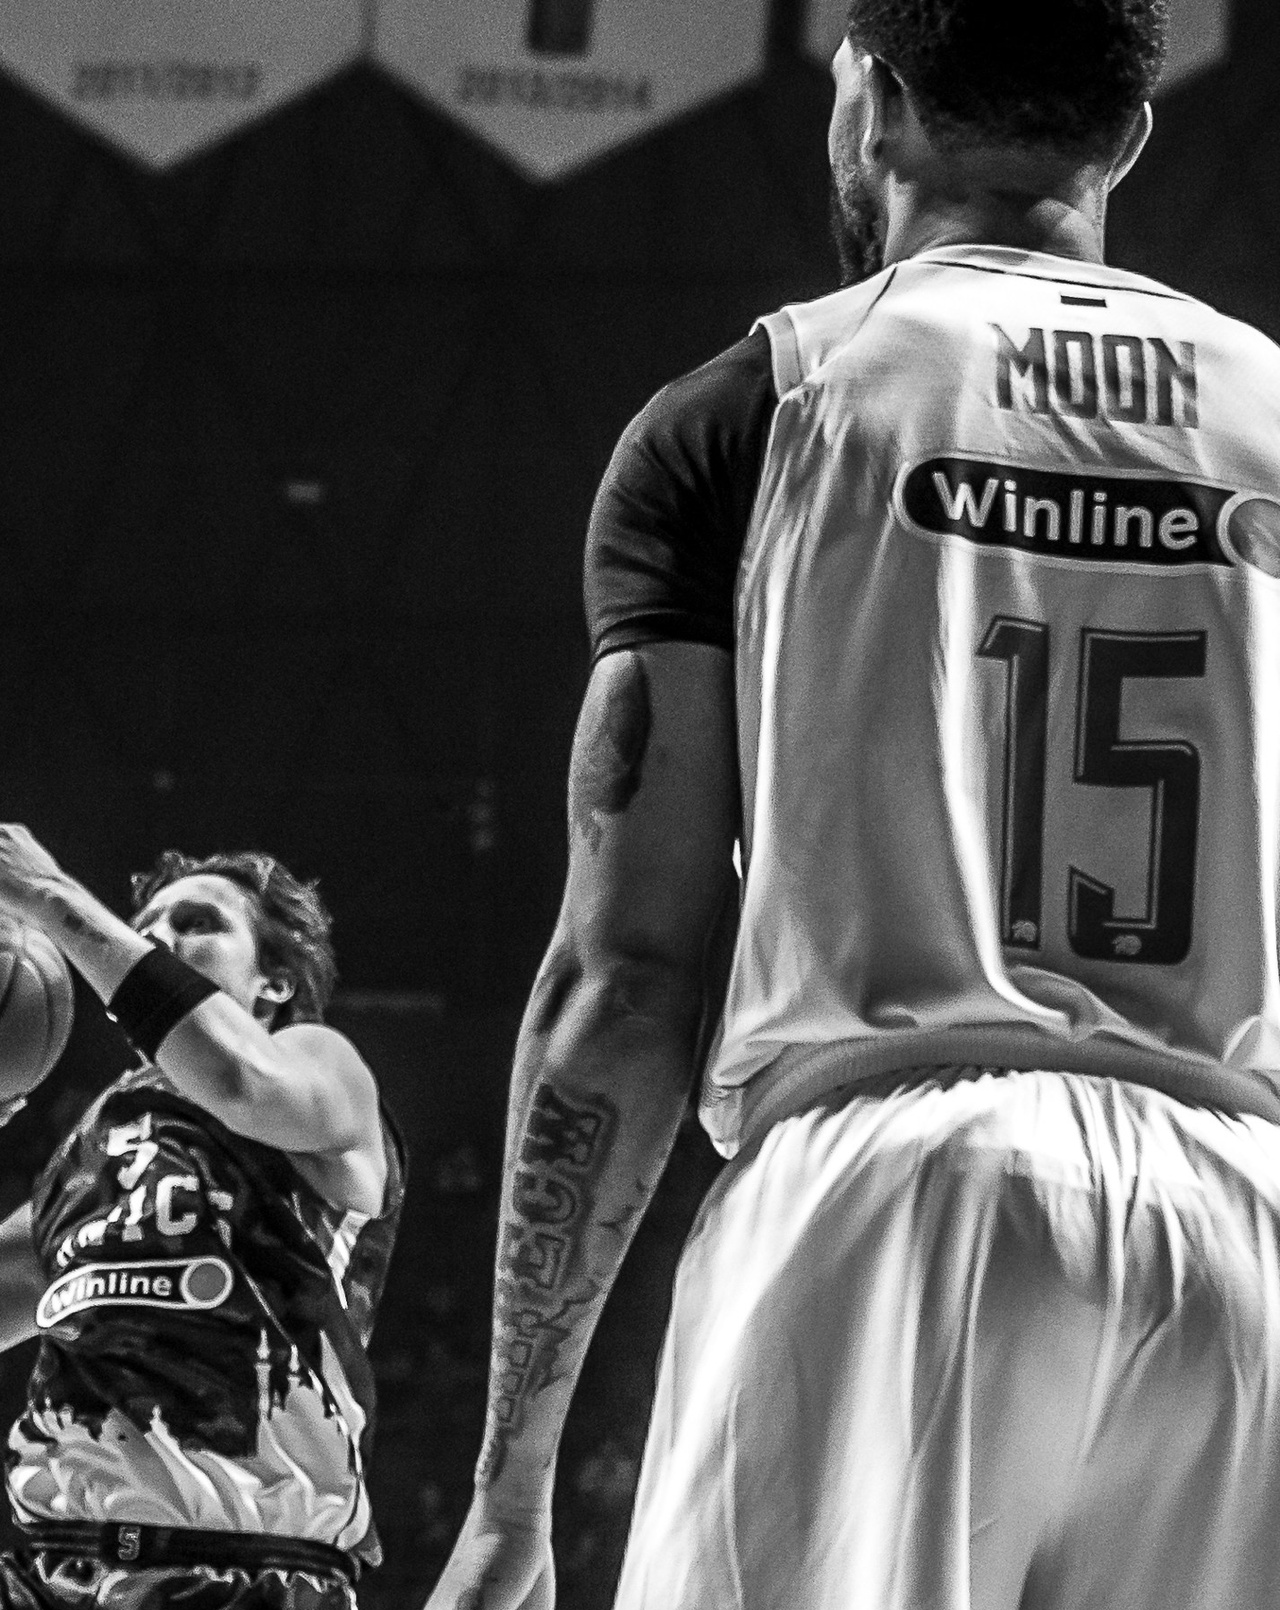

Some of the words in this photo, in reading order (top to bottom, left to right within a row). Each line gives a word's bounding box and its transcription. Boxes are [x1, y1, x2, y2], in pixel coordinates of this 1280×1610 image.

[988, 322, 1199, 430] MOON
[931, 471, 1199, 550] Winline
[976, 614, 1208, 965] 15
[107, 1112, 159, 1190] 5
